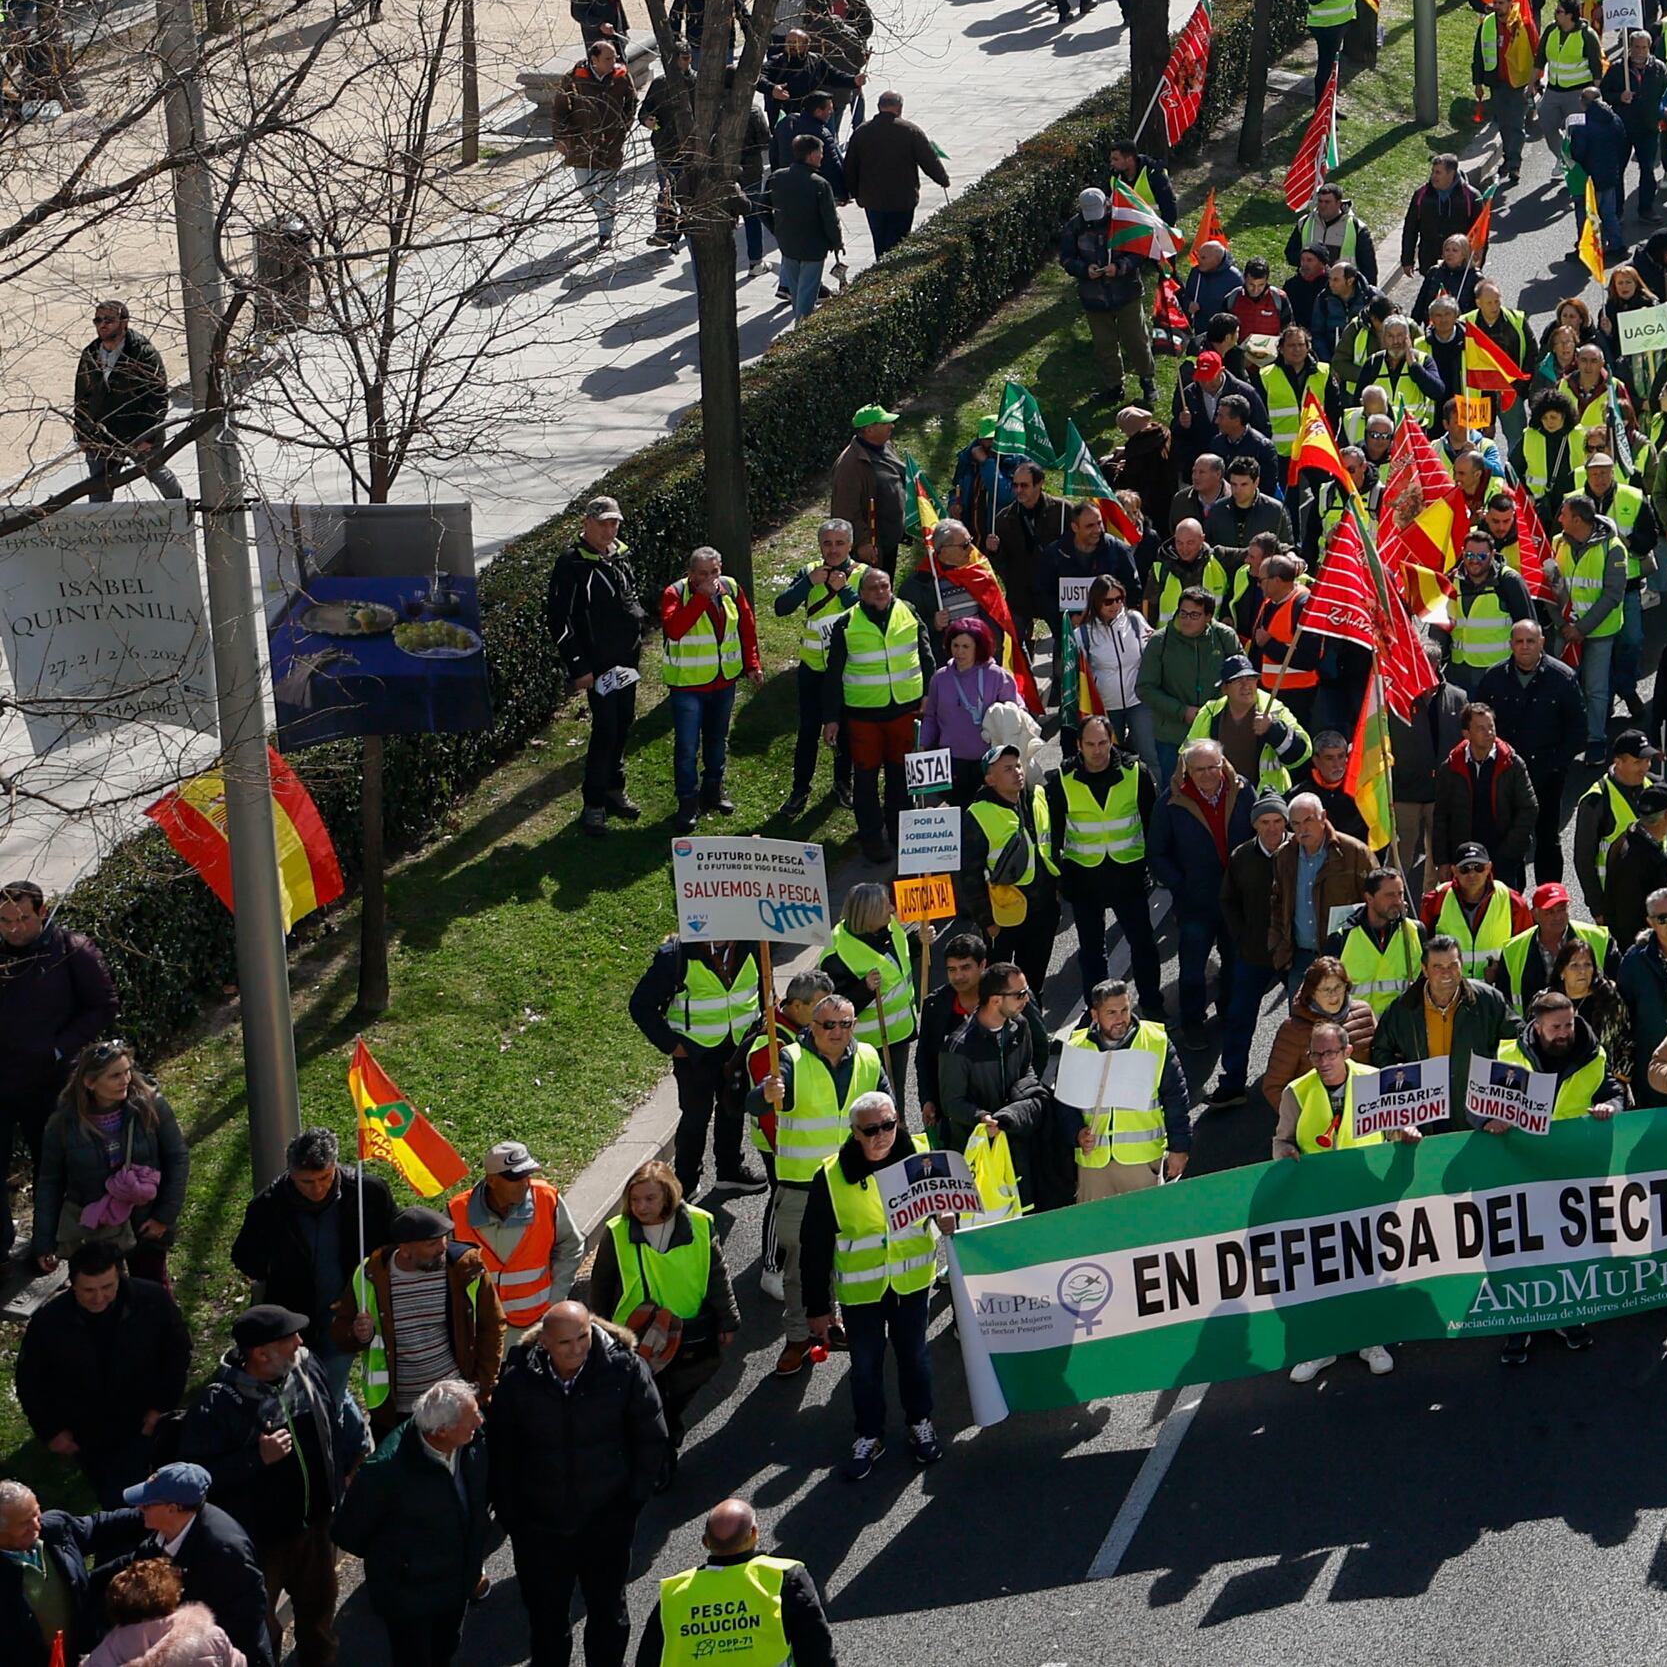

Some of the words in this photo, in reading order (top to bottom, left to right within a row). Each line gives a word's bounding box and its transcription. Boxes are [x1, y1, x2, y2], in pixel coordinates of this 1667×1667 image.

[1606, 7, 1637, 20] UAGA
[1624, 323, 1665, 340] UAGA
[59, 579, 153, 597] ISABEL
[12, 602, 198, 637] QUINTANILLA
[107, 699, 178, 716] MADRID
[905, 829, 954, 840] SOBERANÍA
[900, 844, 958, 855] ALIMENTARIA
[707, 852, 752, 861] FUTURO
[755, 853, 769, 862] DA
[772, 854, 804, 866] PESCA
[779, 866, 805, 875] GALICIA
[684, 881, 762, 898] SALVEMOS
[766, 883, 776, 899] A
[779, 883, 821, 903] PESCA
[1356, 1099, 1446, 1136] ¡DIMISIÓN!
[1468, 1091, 1547, 1132] ¡DIMISIÓN!
[890, 1191, 982, 1231] ¡DIMISIÓN!
[1133, 1248, 1200, 1318] EN
[1217, 1200, 1440, 1301] DEFENSA
[1454, 1192, 1544, 1259] DEL
[1448, 1315, 1505, 1331] Asociación
[1507, 1310, 1559, 1325] Andaluza
[1560, 1308, 1574, 1319] de
[1576, 1301, 1620, 1317] Mujeres
[1621, 1298, 1638, 1309] del
[691, 1600, 748, 1619] PESCA
[680, 1614, 760, 1636] SOLUCIÓN
[718, 1636, 753, 1648] OPP-71
